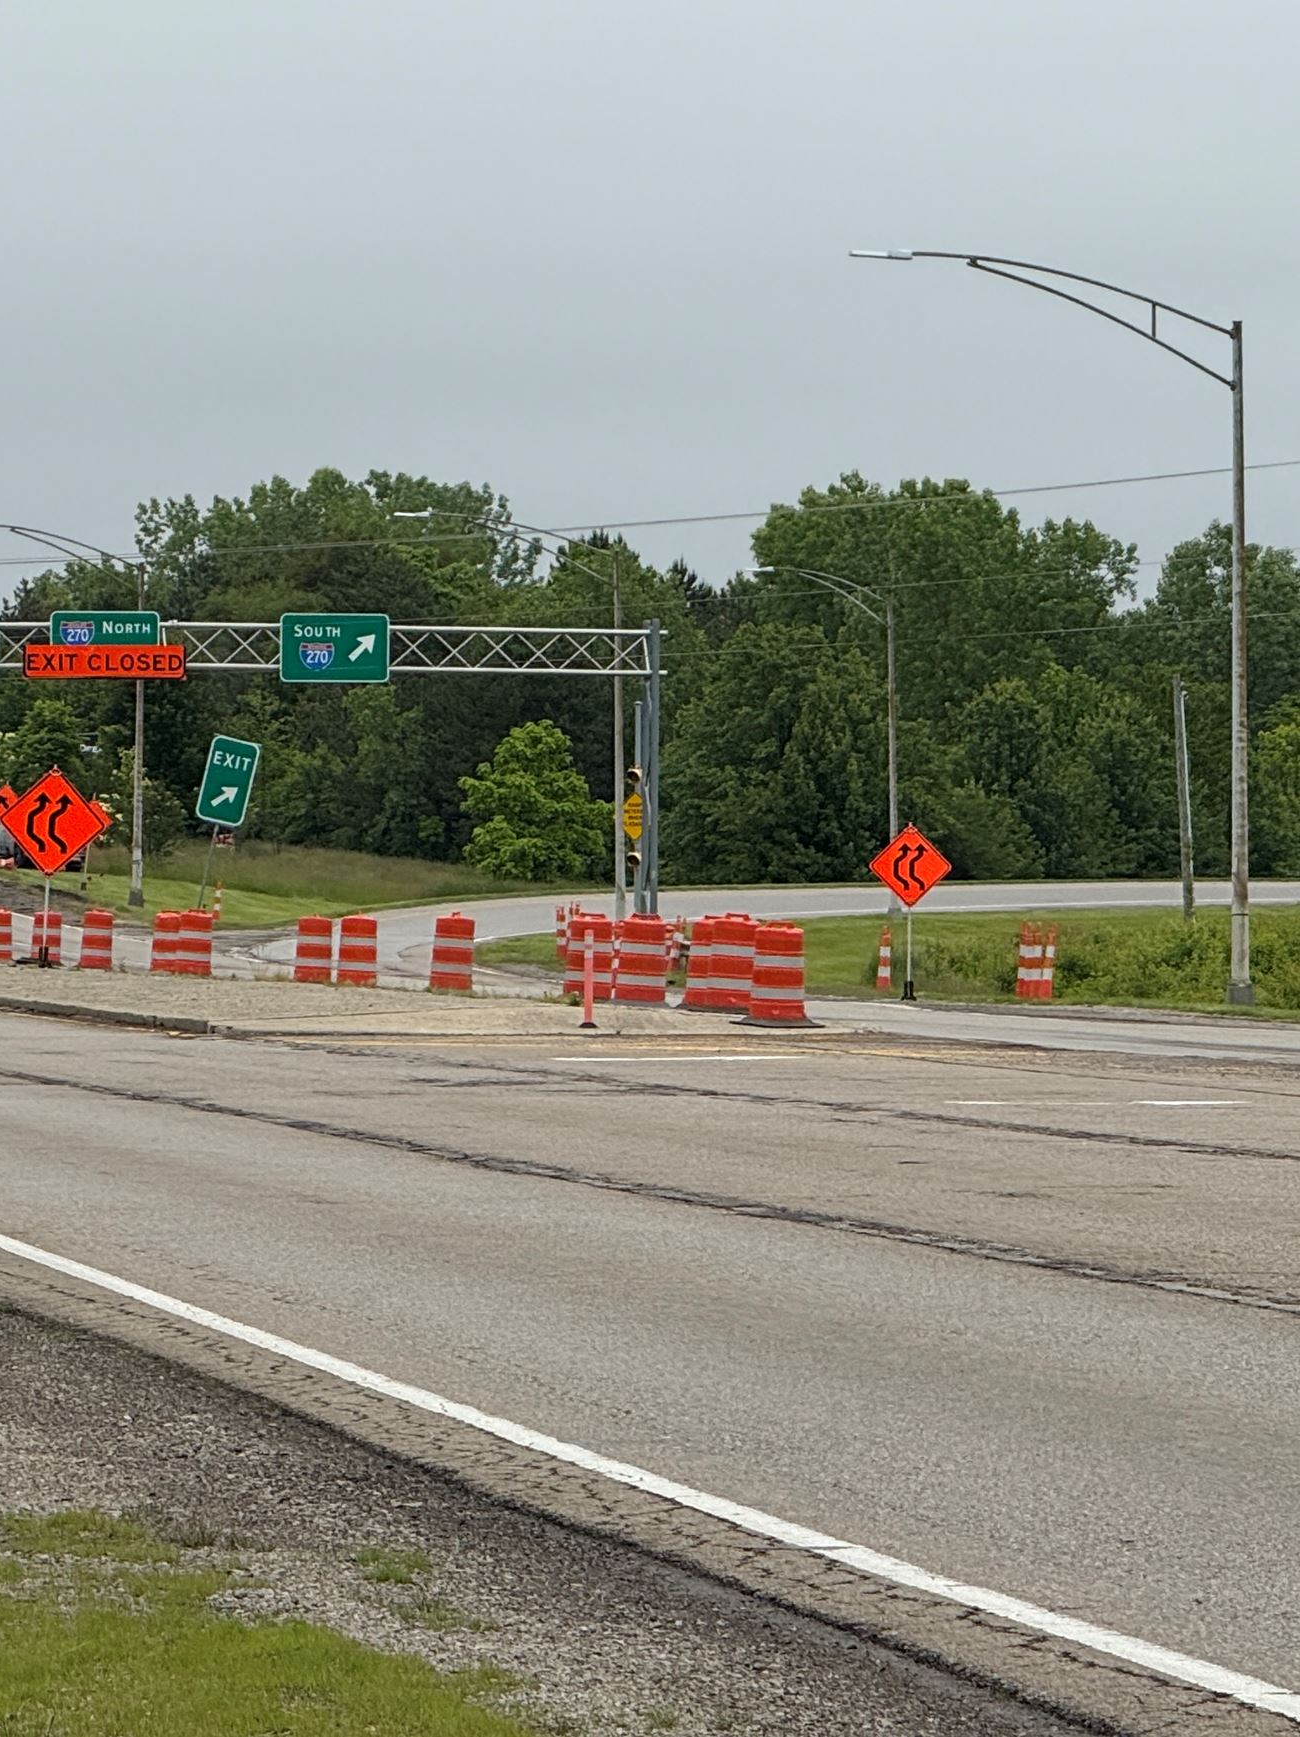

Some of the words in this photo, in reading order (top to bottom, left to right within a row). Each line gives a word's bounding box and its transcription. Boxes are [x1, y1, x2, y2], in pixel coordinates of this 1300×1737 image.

[66, 628, 89, 642] 270
[27, 653, 79, 671] EXIT
[87, 653, 183, 671] CLOSED
[306, 651, 329, 664] 270
[213, 751, 252, 772] EXIT
